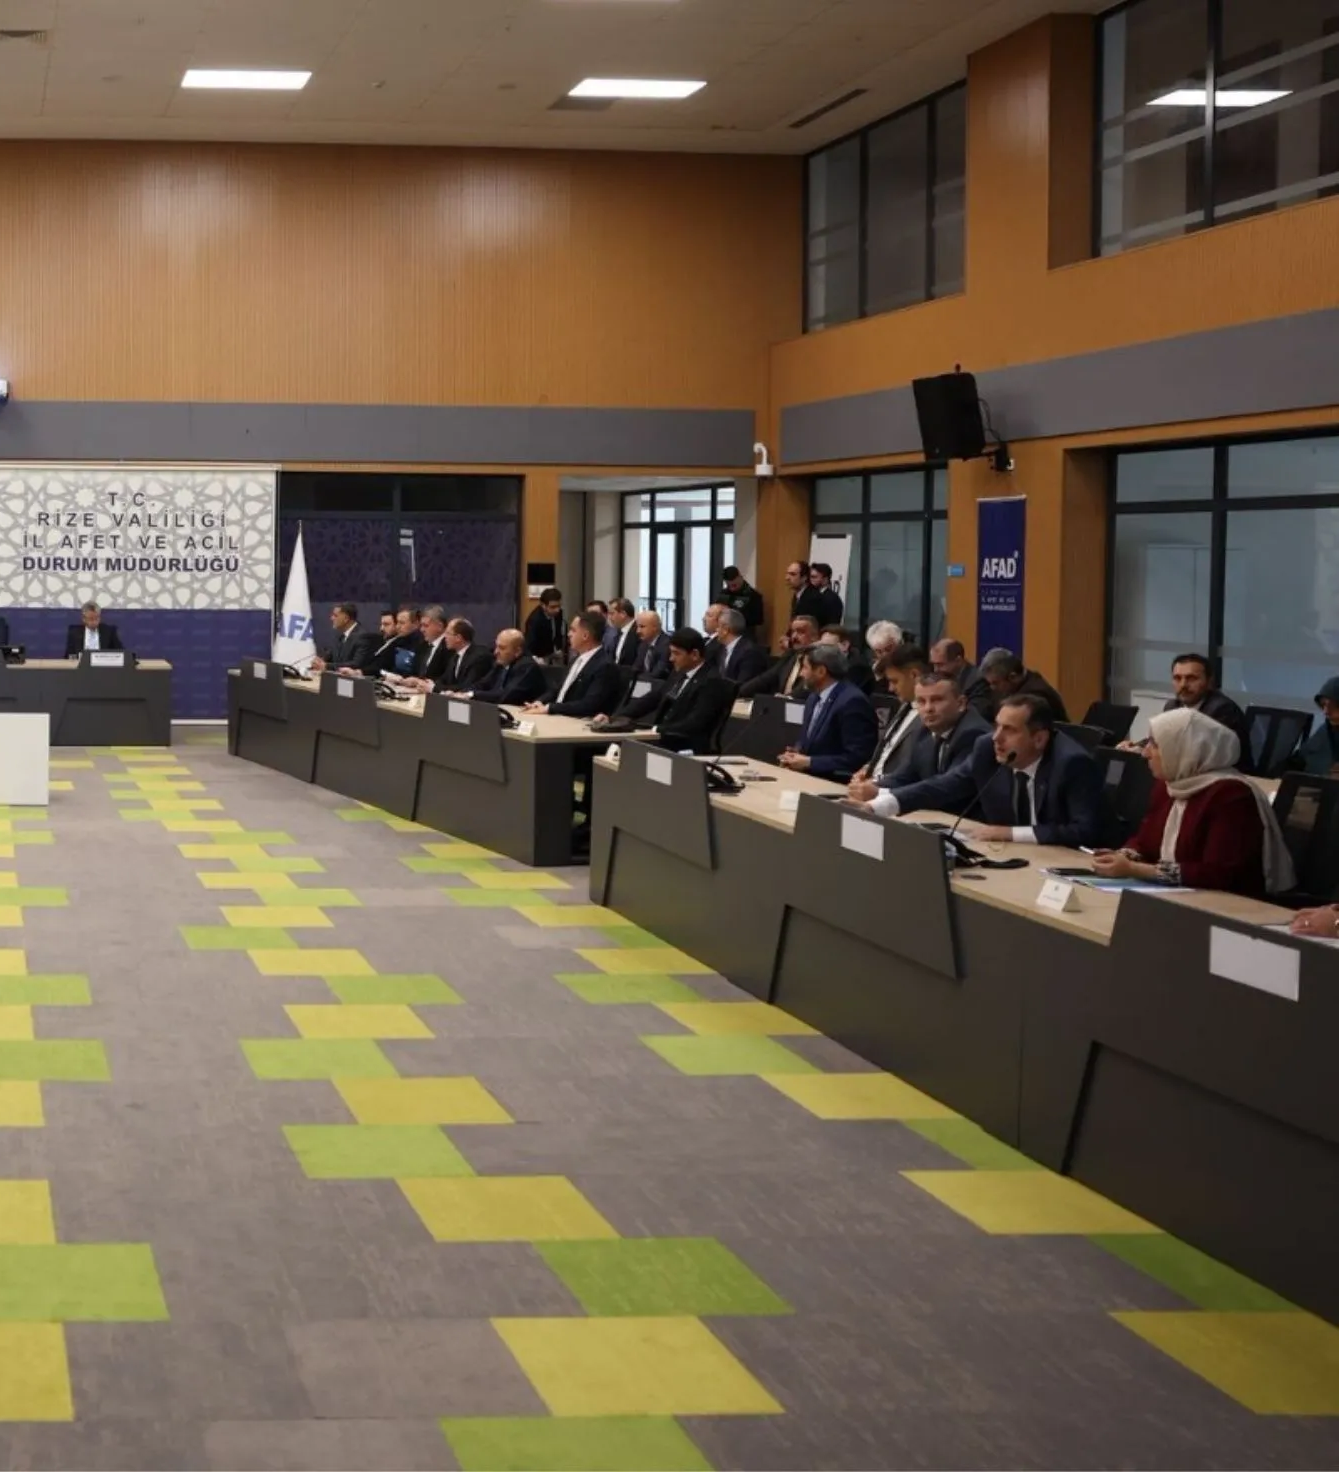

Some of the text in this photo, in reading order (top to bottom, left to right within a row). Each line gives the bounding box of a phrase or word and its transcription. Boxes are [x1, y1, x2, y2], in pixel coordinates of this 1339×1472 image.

[37, 509, 225, 528] RİZE VALİLİĞİ
[23, 531, 238, 549] İL AFET VE ACİL
[23, 555, 239, 572] DURUM MÜDÜRLÜĞÜ
[982, 558, 1017, 579] AFAD
